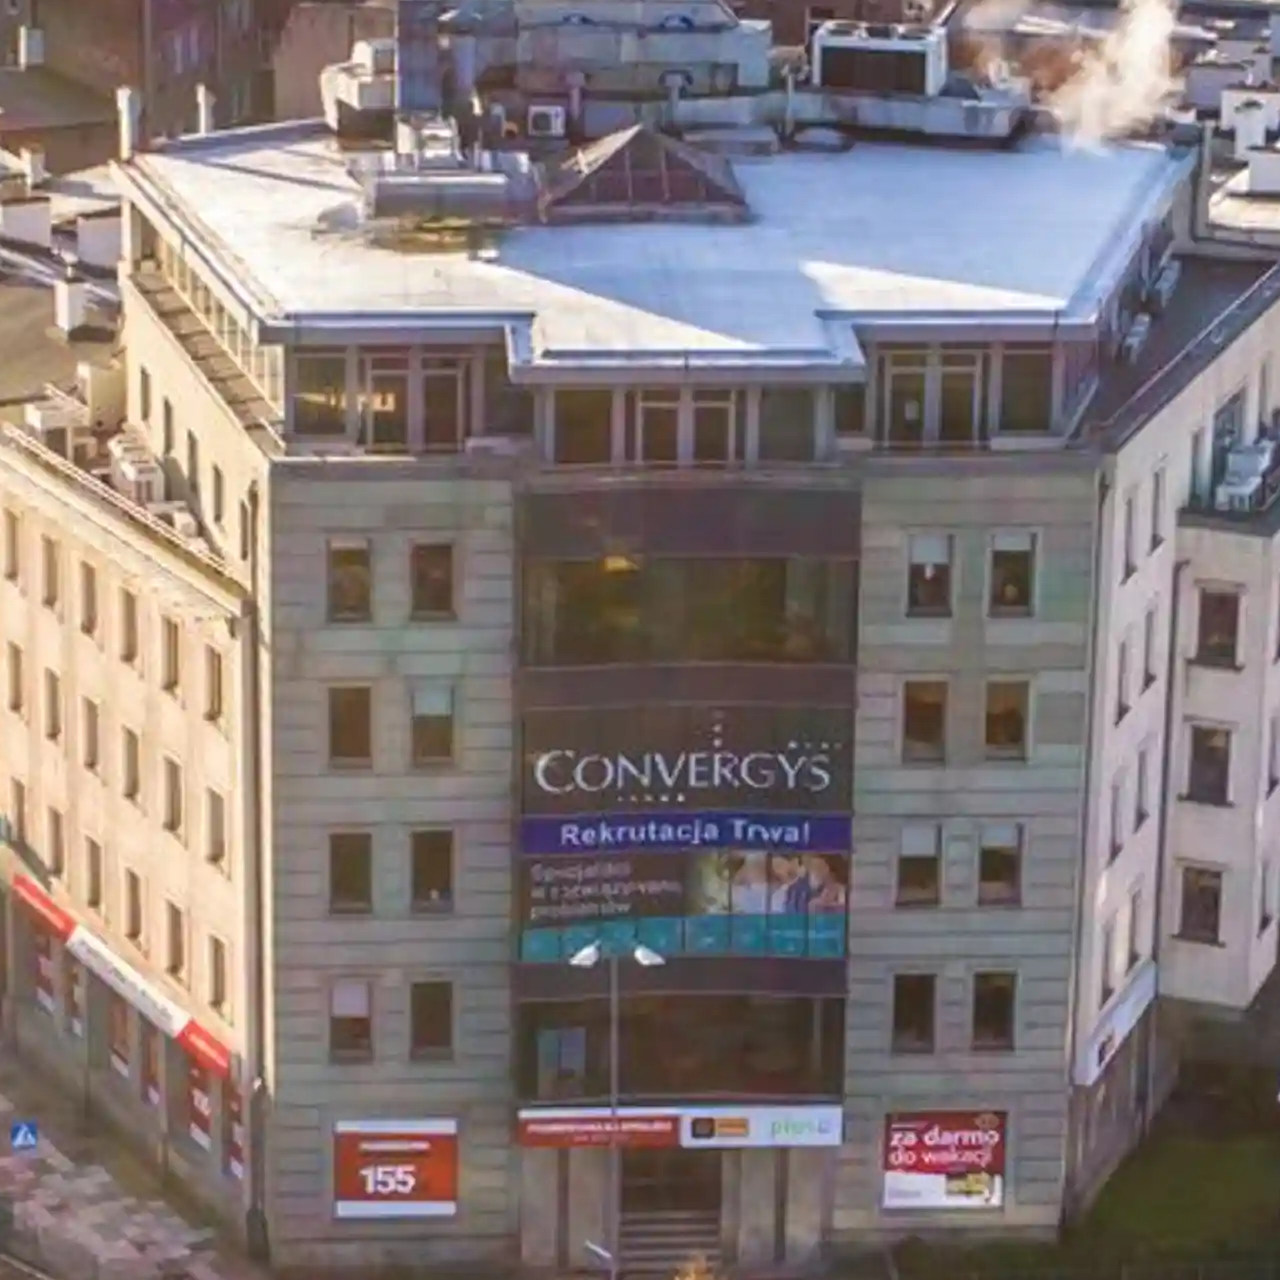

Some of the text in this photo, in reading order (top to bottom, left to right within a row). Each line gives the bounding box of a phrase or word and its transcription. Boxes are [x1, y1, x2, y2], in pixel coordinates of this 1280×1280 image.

[534, 749, 831, 793] CONVERGYS
[560, 819, 719, 846] Rekrutacja
[360, 1164, 416, 1195] 155
